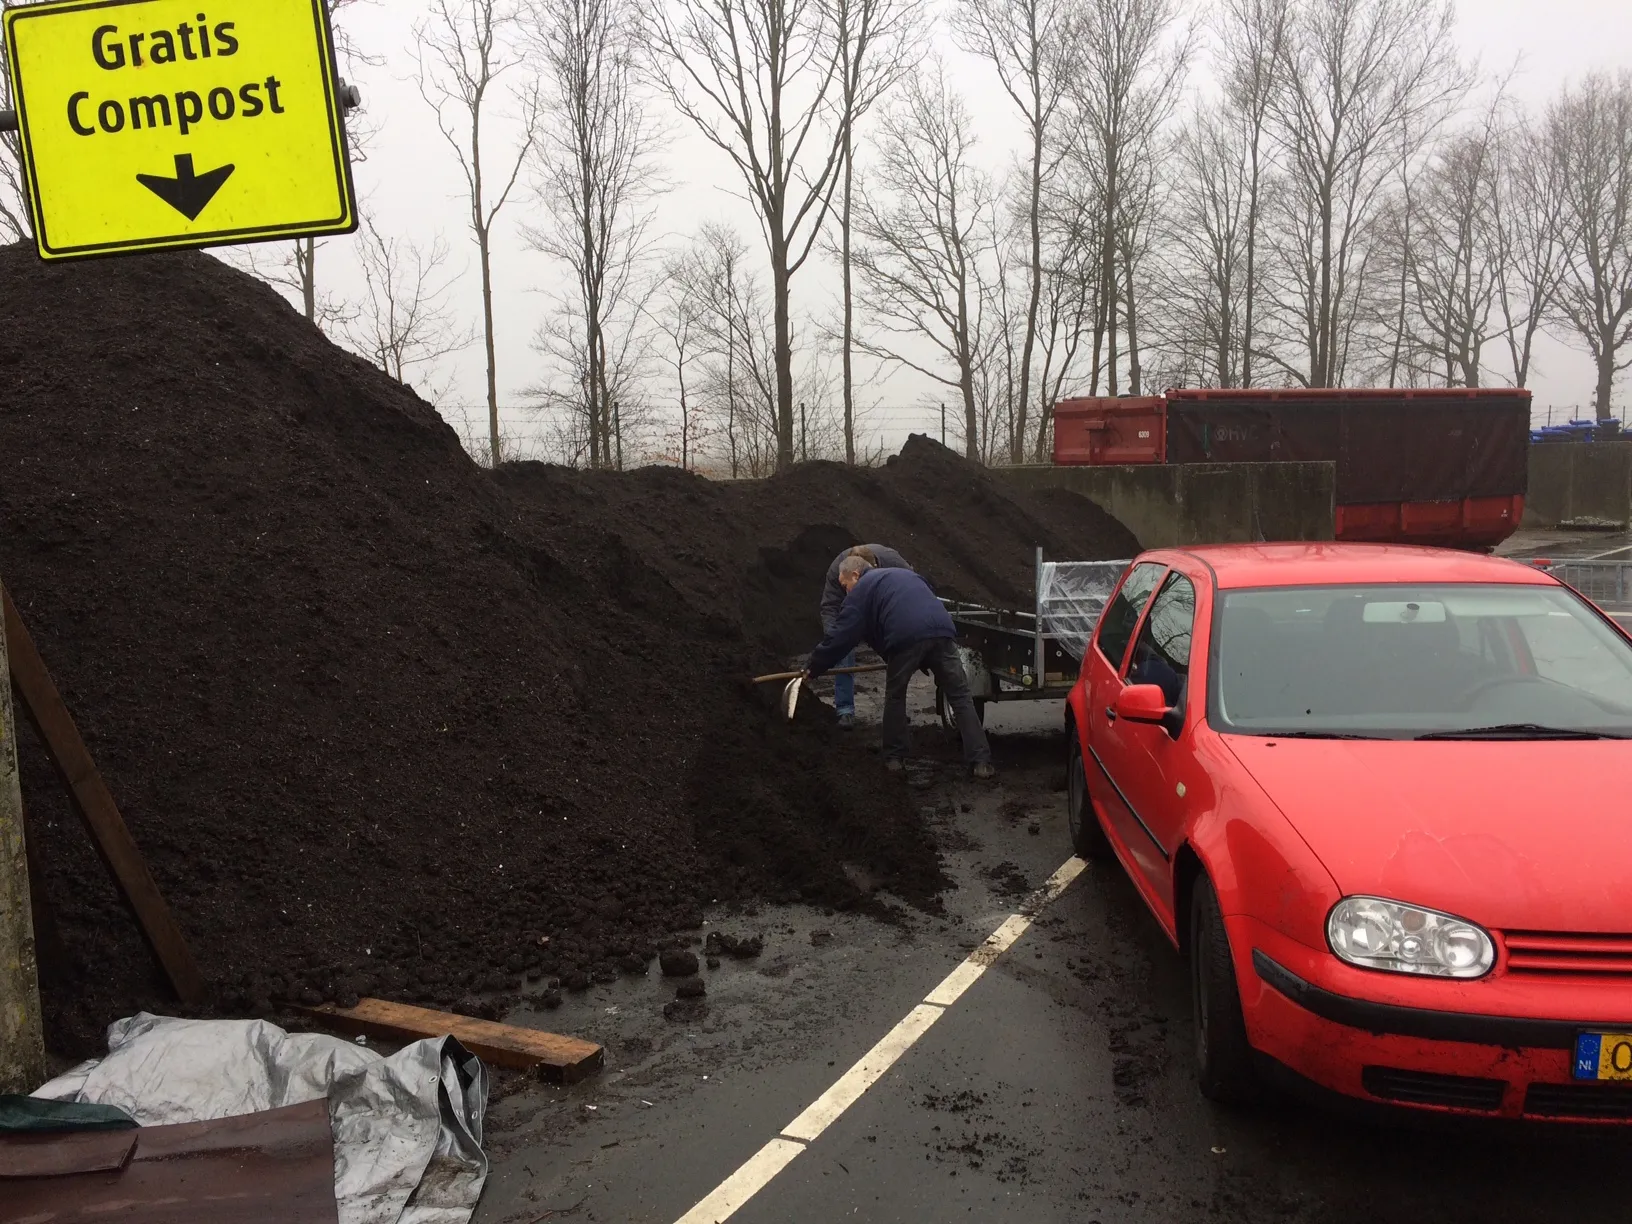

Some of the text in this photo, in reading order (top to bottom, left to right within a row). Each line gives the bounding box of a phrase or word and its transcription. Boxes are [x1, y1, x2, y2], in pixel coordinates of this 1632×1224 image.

[92, 13, 239, 70] Gratis
[67, 76, 285, 136] Compost
[1579, 1060, 1593, 1071] NL
